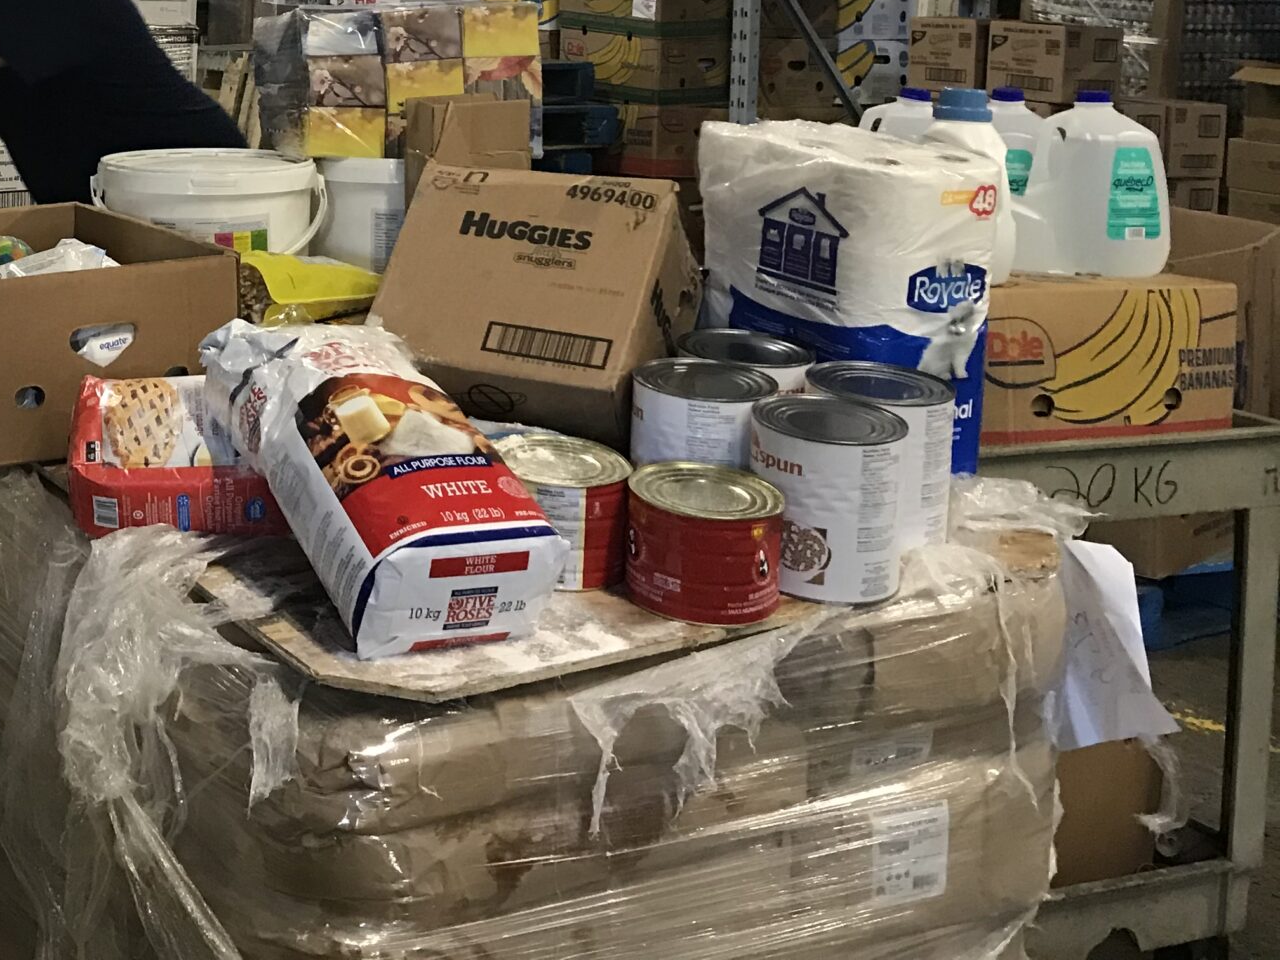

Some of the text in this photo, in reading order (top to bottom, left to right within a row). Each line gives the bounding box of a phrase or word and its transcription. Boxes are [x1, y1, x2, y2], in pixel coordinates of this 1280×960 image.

[971, 189, 995, 212] 48
[459, 210, 592, 250] HUGGIES
[516, 253, 574, 269] snugglers
[914, 273, 983, 308] Royale
[100, 337, 128, 350] equate
[987, 330, 1043, 359] Dole
[1179, 347, 1236, 368] PREMIUM
[1180, 370, 1235, 391] BANANAS
[393, 455, 487, 475] ALL PURPOSE FLOUR
[421, 480, 493, 499] WHITE
[1134, 460, 1178, 507] KG
[440, 507, 506, 523] 10 kg (22 lb)
[389, 520, 427, 540] ENRICHED
[465, 555, 497, 566] WHITE
[465, 564, 495, 575] FLOUR
[464, 595, 497, 609] FIVE
[498, 599, 526, 613] 22 lb
[408, 605, 442, 621] 10 kg
[446, 606, 494, 622] ROSES
